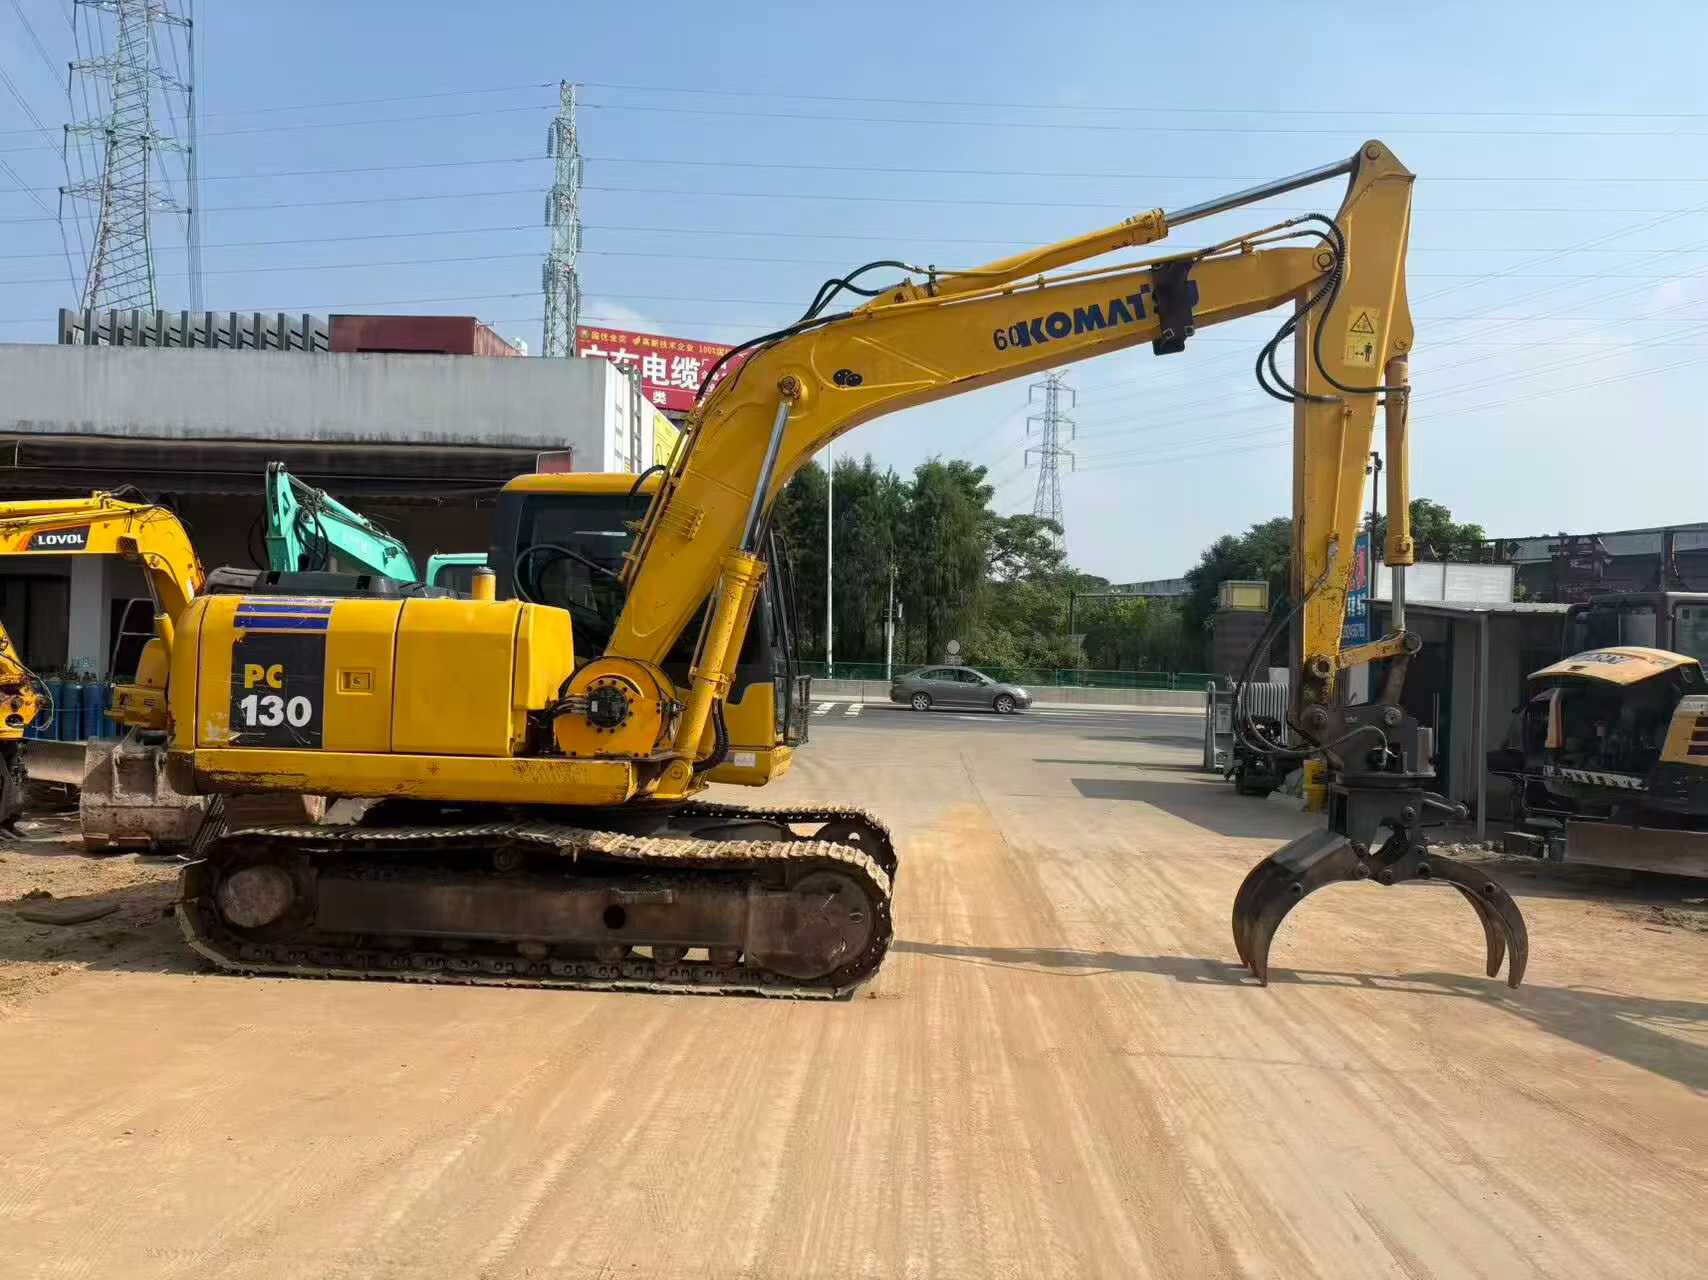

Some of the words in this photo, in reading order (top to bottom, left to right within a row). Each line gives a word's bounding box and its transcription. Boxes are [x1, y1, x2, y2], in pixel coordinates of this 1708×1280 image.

[38, 534, 85, 546] LOVOL
[244, 664, 283, 689] PC
[241, 694, 312, 727] 130
